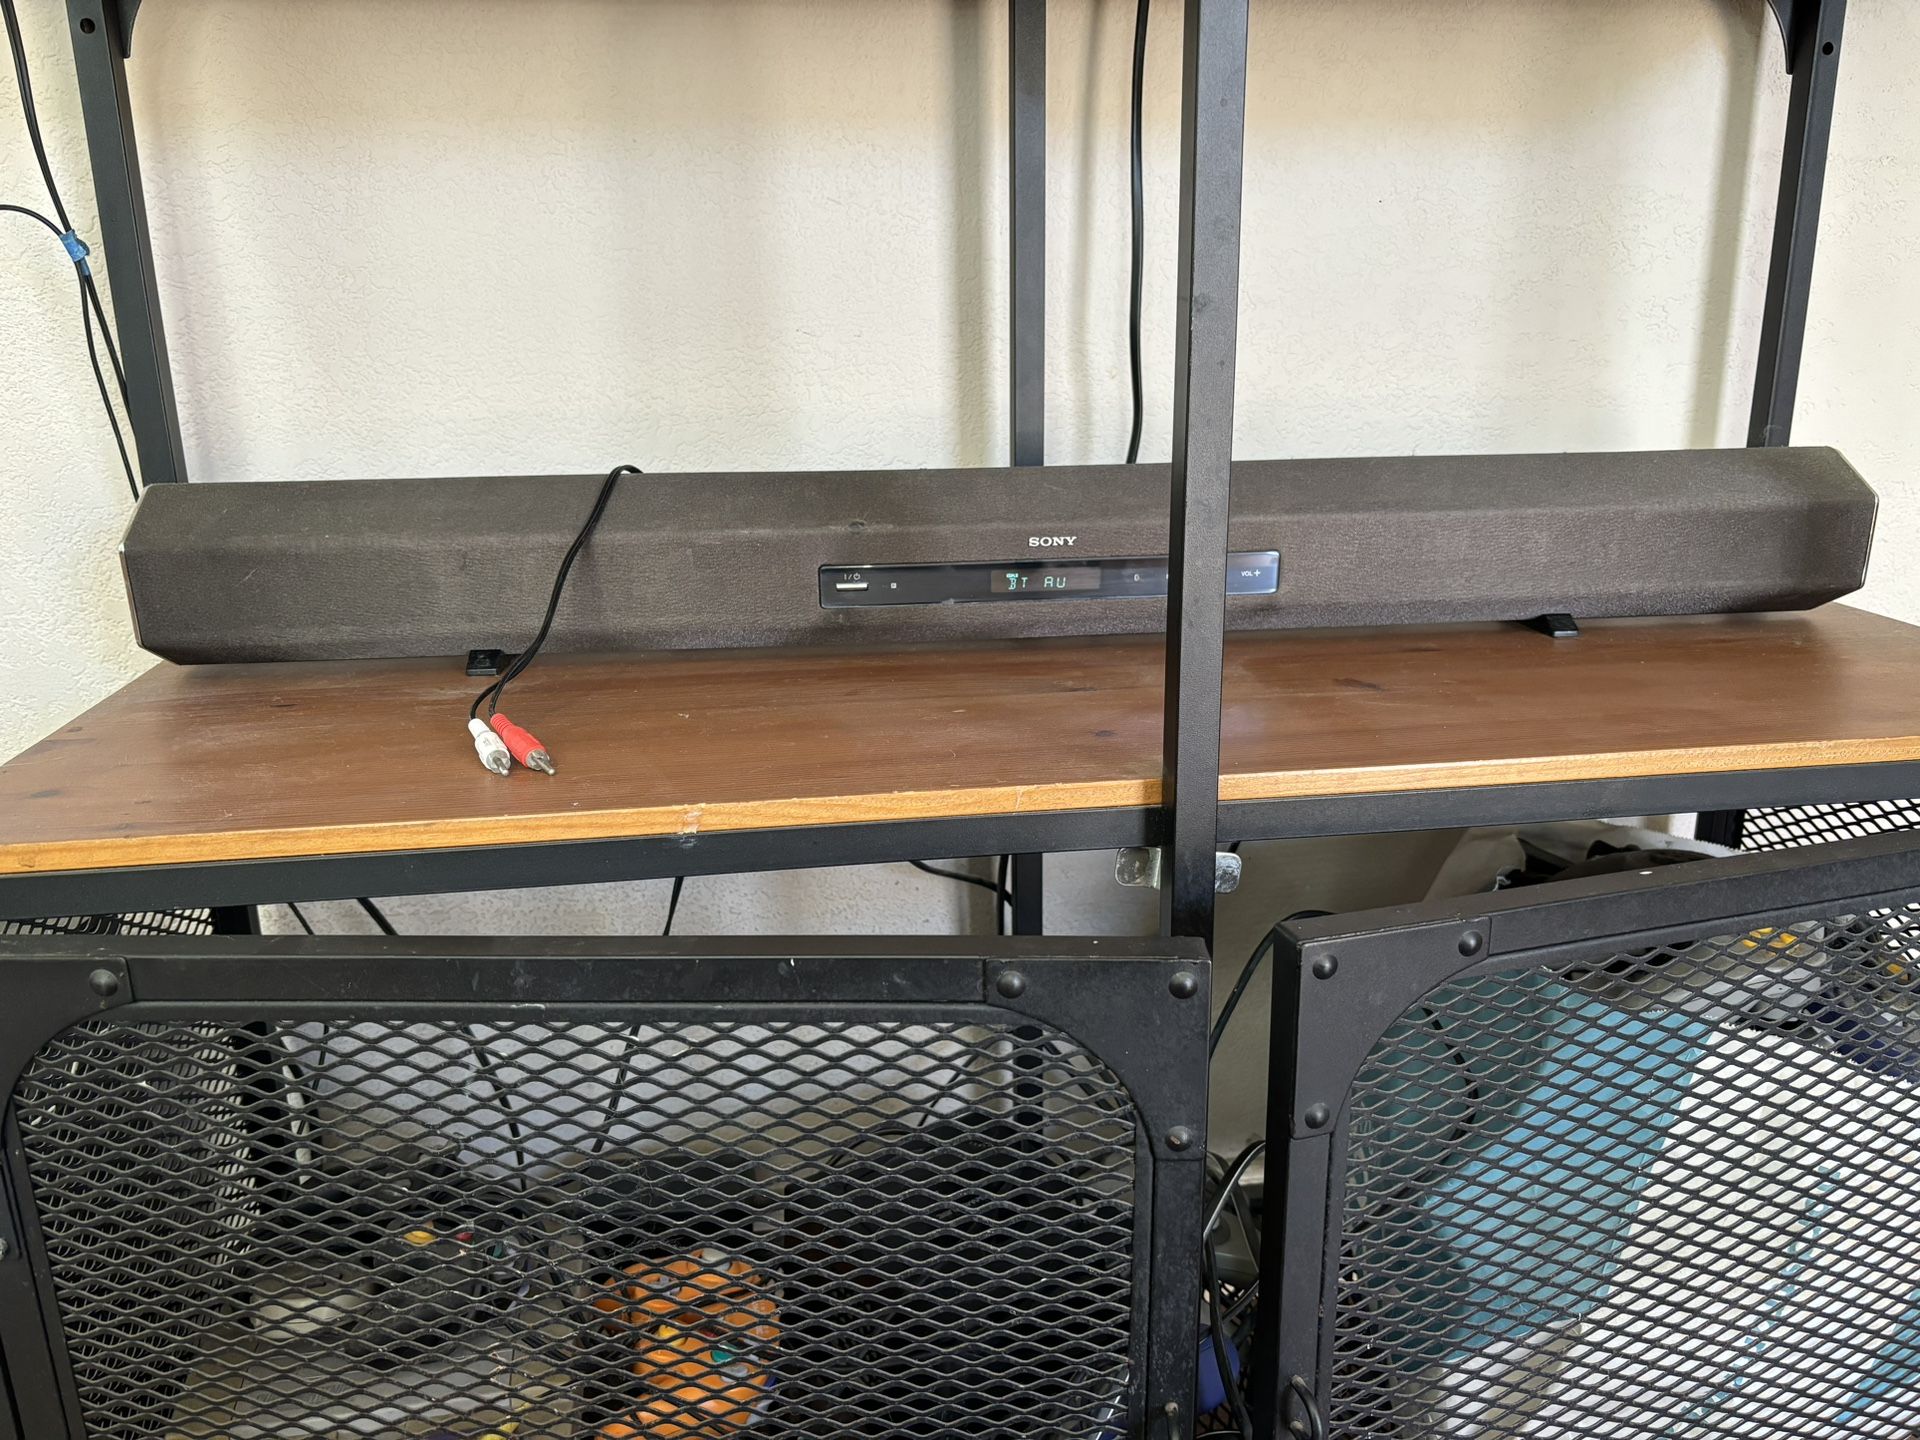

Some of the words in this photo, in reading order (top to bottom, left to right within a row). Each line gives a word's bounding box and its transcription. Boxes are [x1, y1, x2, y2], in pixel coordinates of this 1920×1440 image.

[1028, 536, 1077, 547] SONY
[1008, 577, 1028, 590] BT
[1043, 576, 1067, 588] AU
